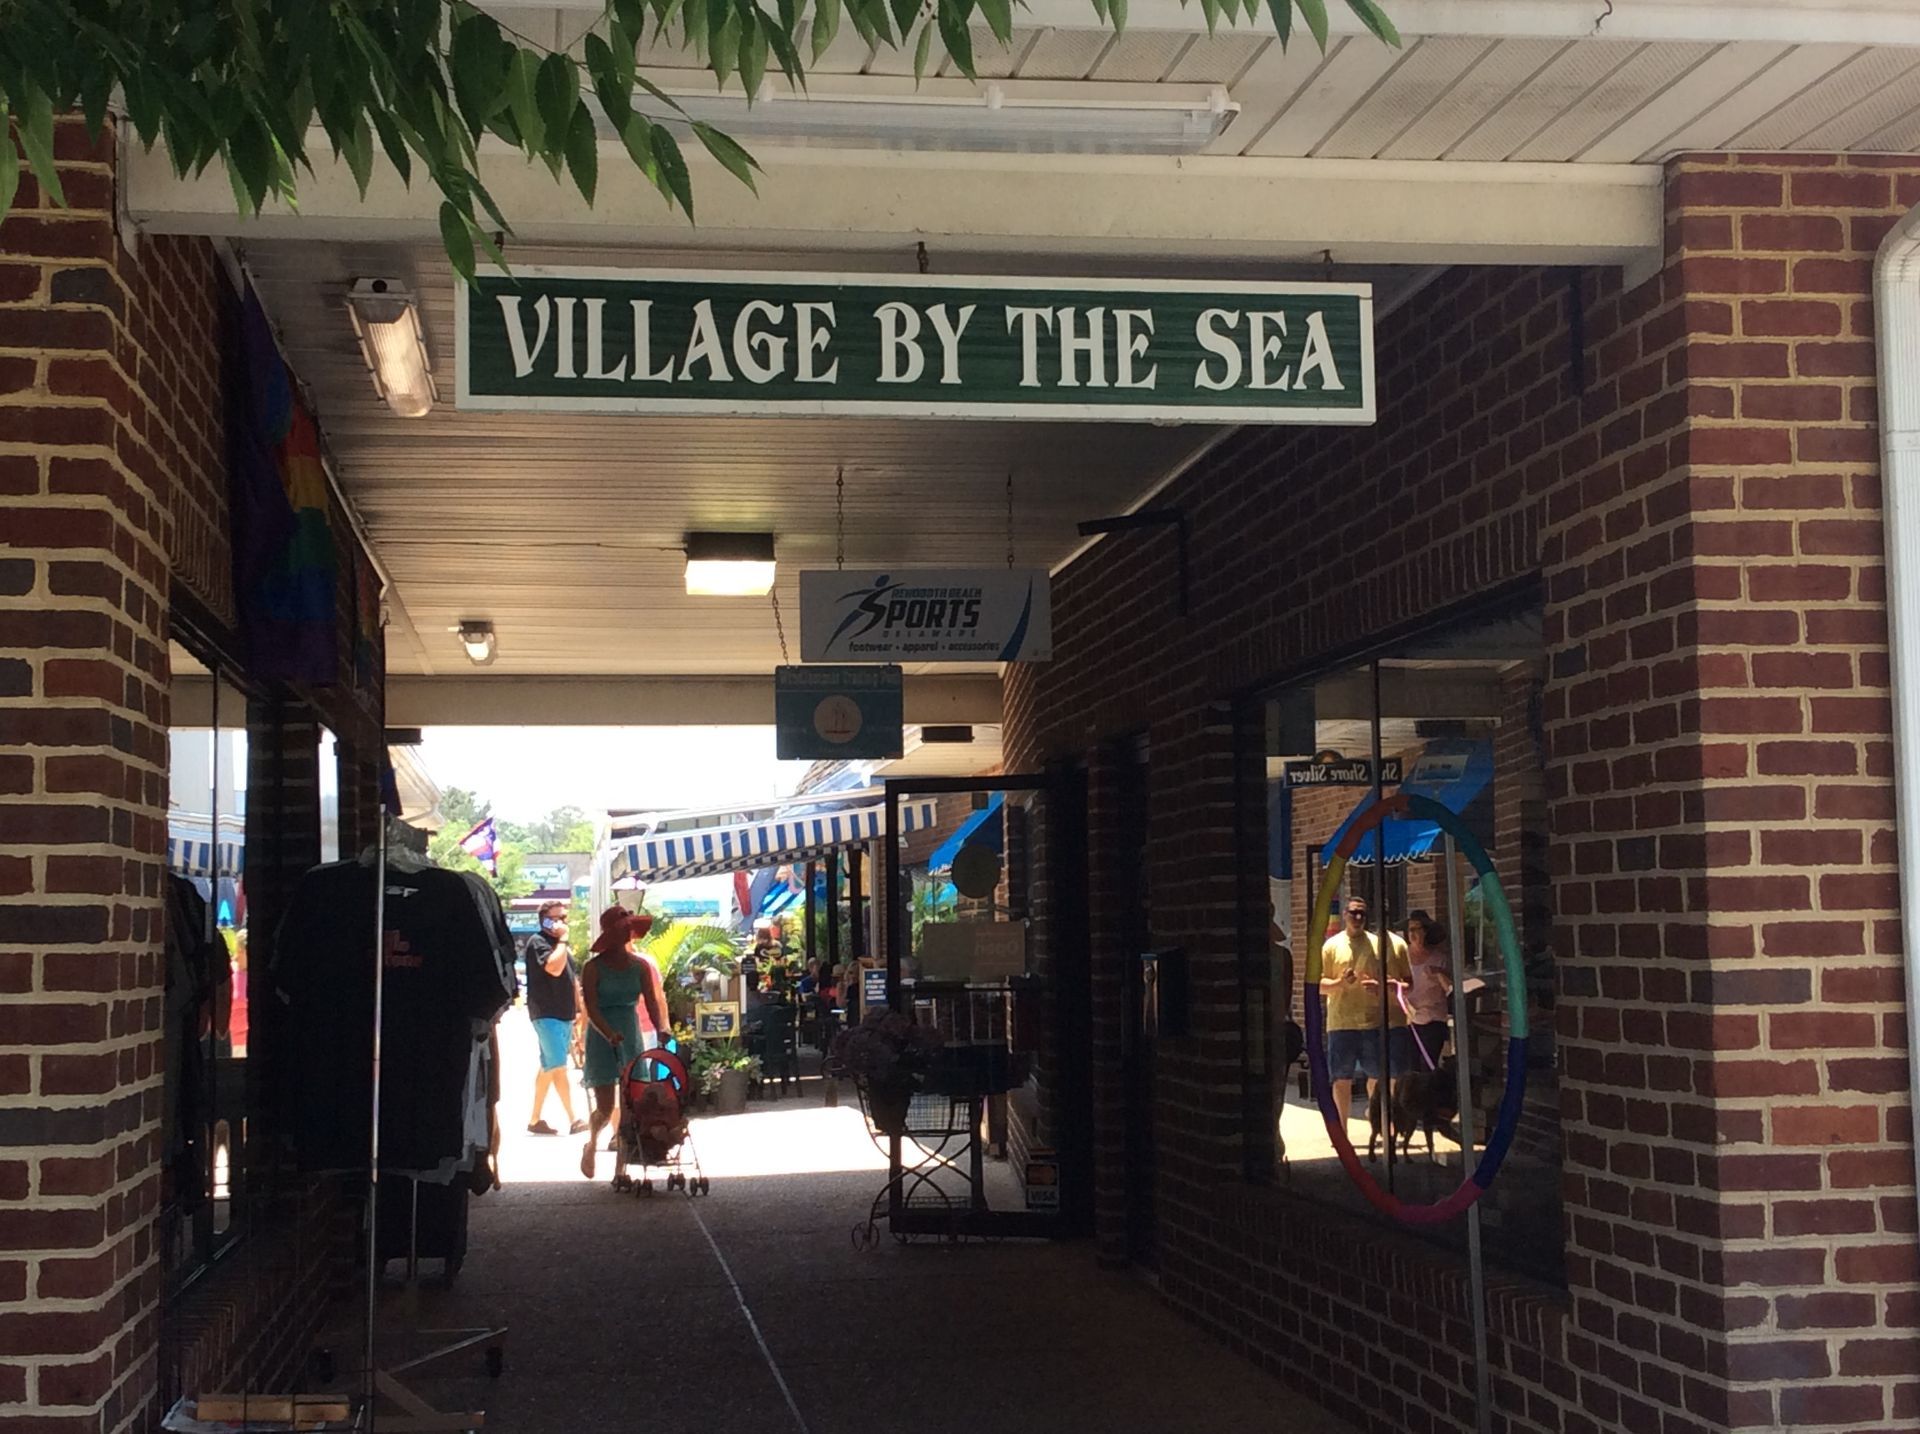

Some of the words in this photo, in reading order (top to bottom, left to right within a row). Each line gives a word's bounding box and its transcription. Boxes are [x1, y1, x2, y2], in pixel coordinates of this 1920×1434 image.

[496, 294, 839, 385] VILLAGE
[873, 301, 977, 386] BY
[1005, 305, 1158, 390] THE
[1194, 308, 1346, 392] SEA
[948, 588, 982, 599] BEACH
[859, 597, 982, 634] SPORTS
[882, 629, 976, 638] DELAWARE
[849, 641, 893, 653] footwear
[902, 641, 939, 654] apparel
[948, 641, 1000, 653] accessories
